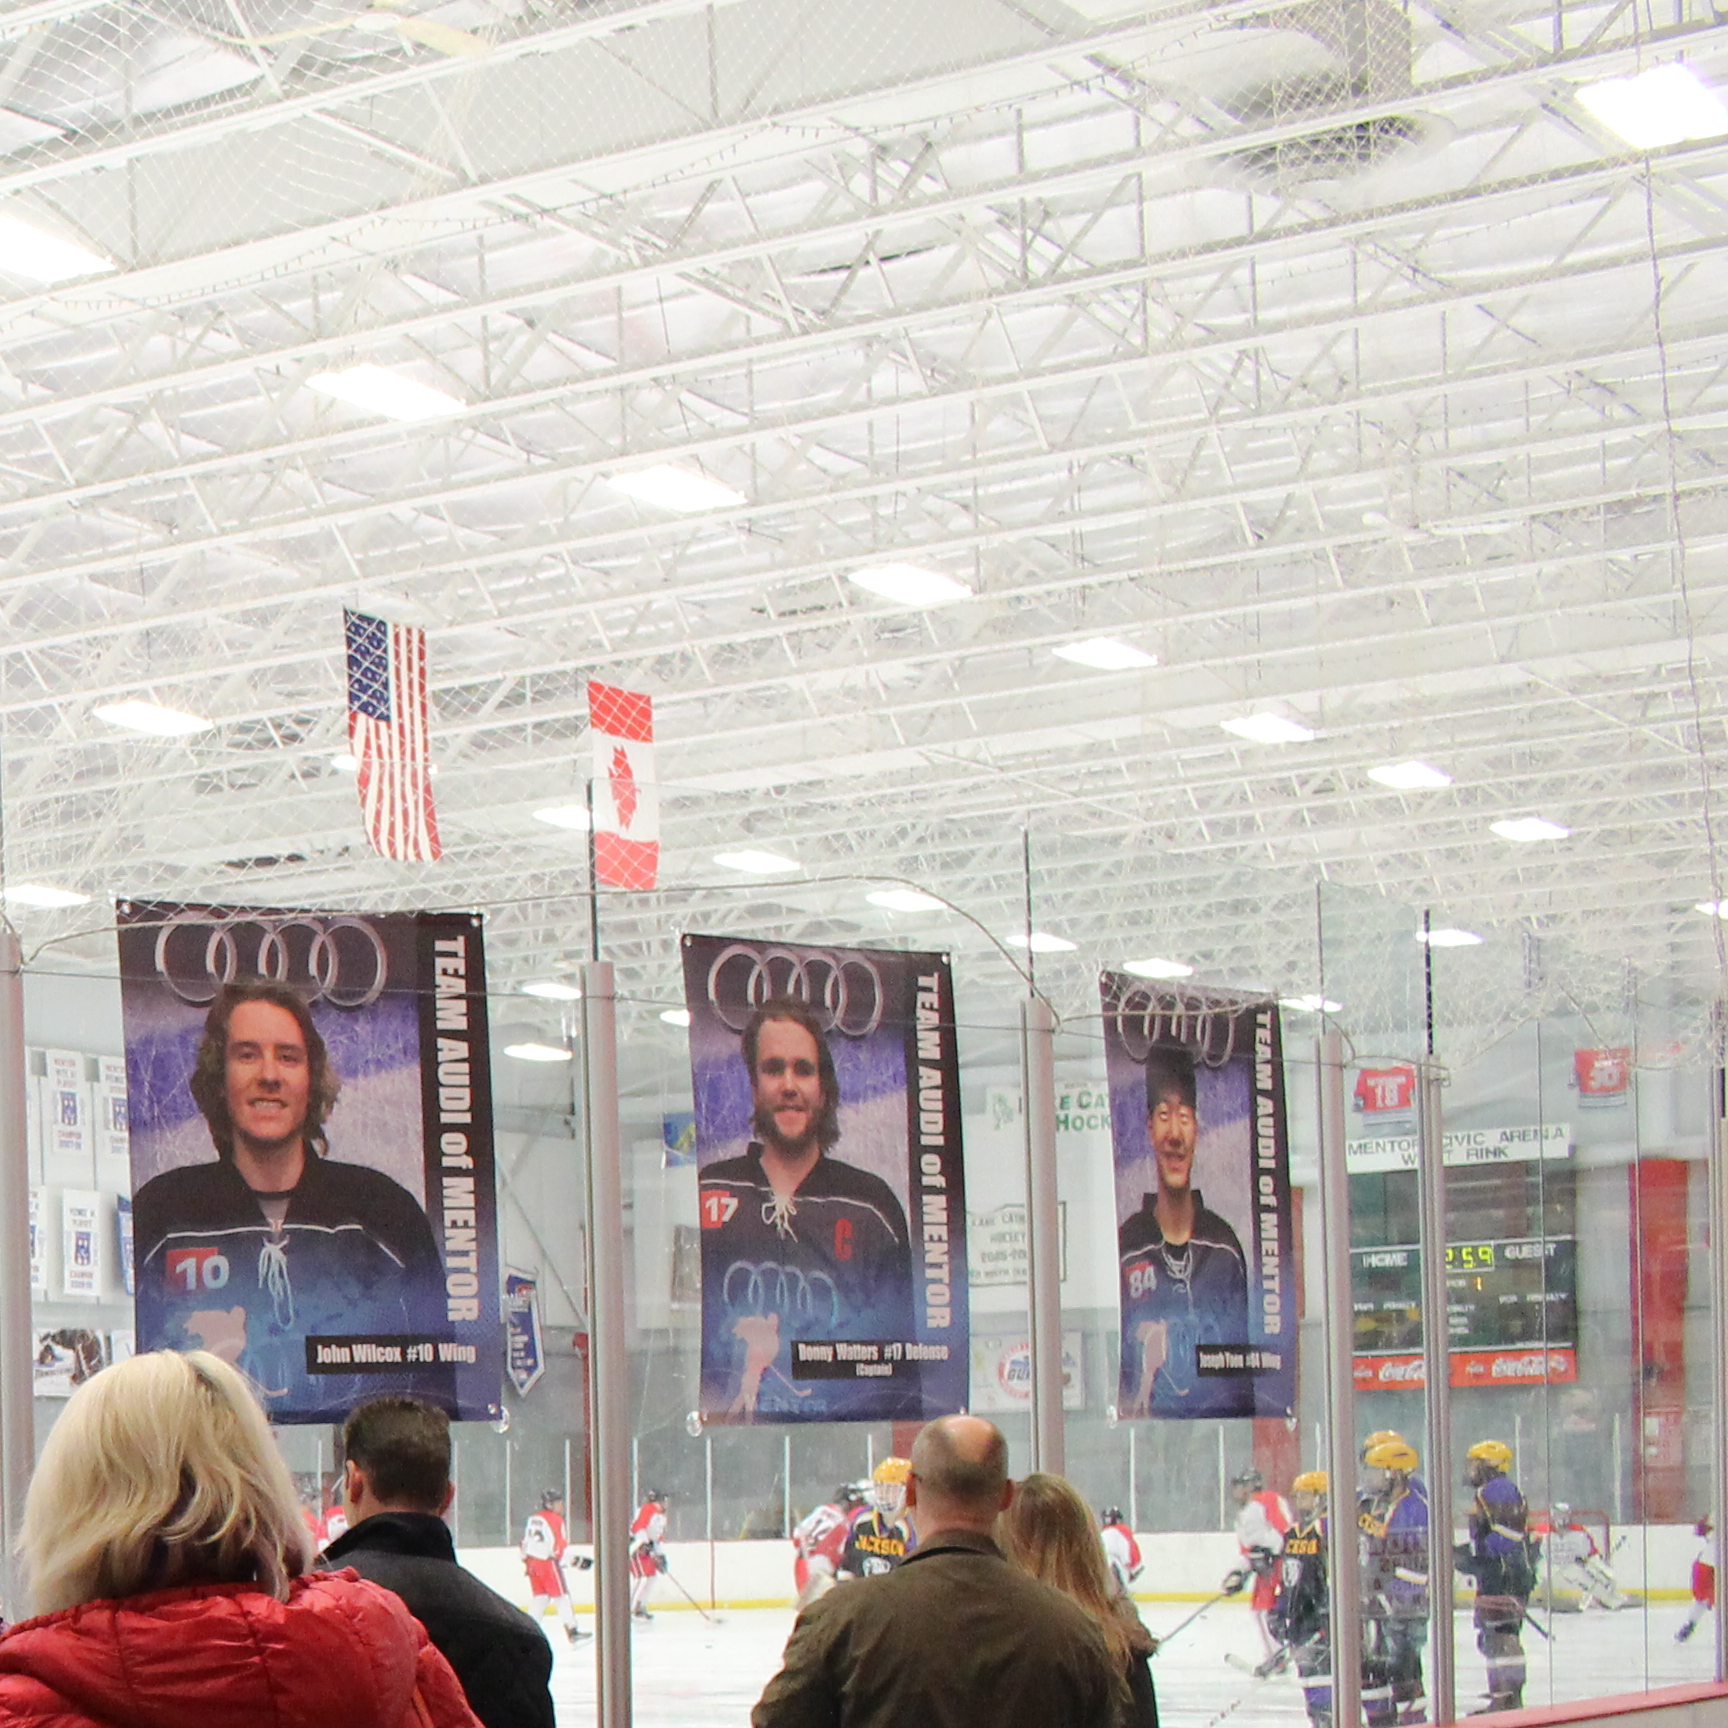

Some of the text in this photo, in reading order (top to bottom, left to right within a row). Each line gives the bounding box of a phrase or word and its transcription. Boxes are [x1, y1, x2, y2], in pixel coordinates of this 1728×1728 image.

[434, 935, 478, 1322] TEAM AUDI of MENTOR
[1500, 1125, 1565, 1145] ARENA
[915, 972, 951, 1330] TEAM AUDI of MENTOR
[1402, 1145, 1510, 1167] WT RINK
[1254, 1010, 1281, 1336] TEAM AUDI of MENTOR
[705, 1195, 739, 1222] 17
[1362, 1252, 1408, 1269] HOME
[1504, 1244, 1557, 1261] GUEST
[175, 1257, 230, 1290] 10
[1128, 1264, 1157, 1298] 84
[1475, 1276, 1484, 1292] 1
[316, 1343, 476, 1364] John Wilcox #10 Wing
[798, 1343, 833, 1362] Donny
[835, 1343, 879, 1361] Watters
[905, 1343, 950, 1361] Defense
